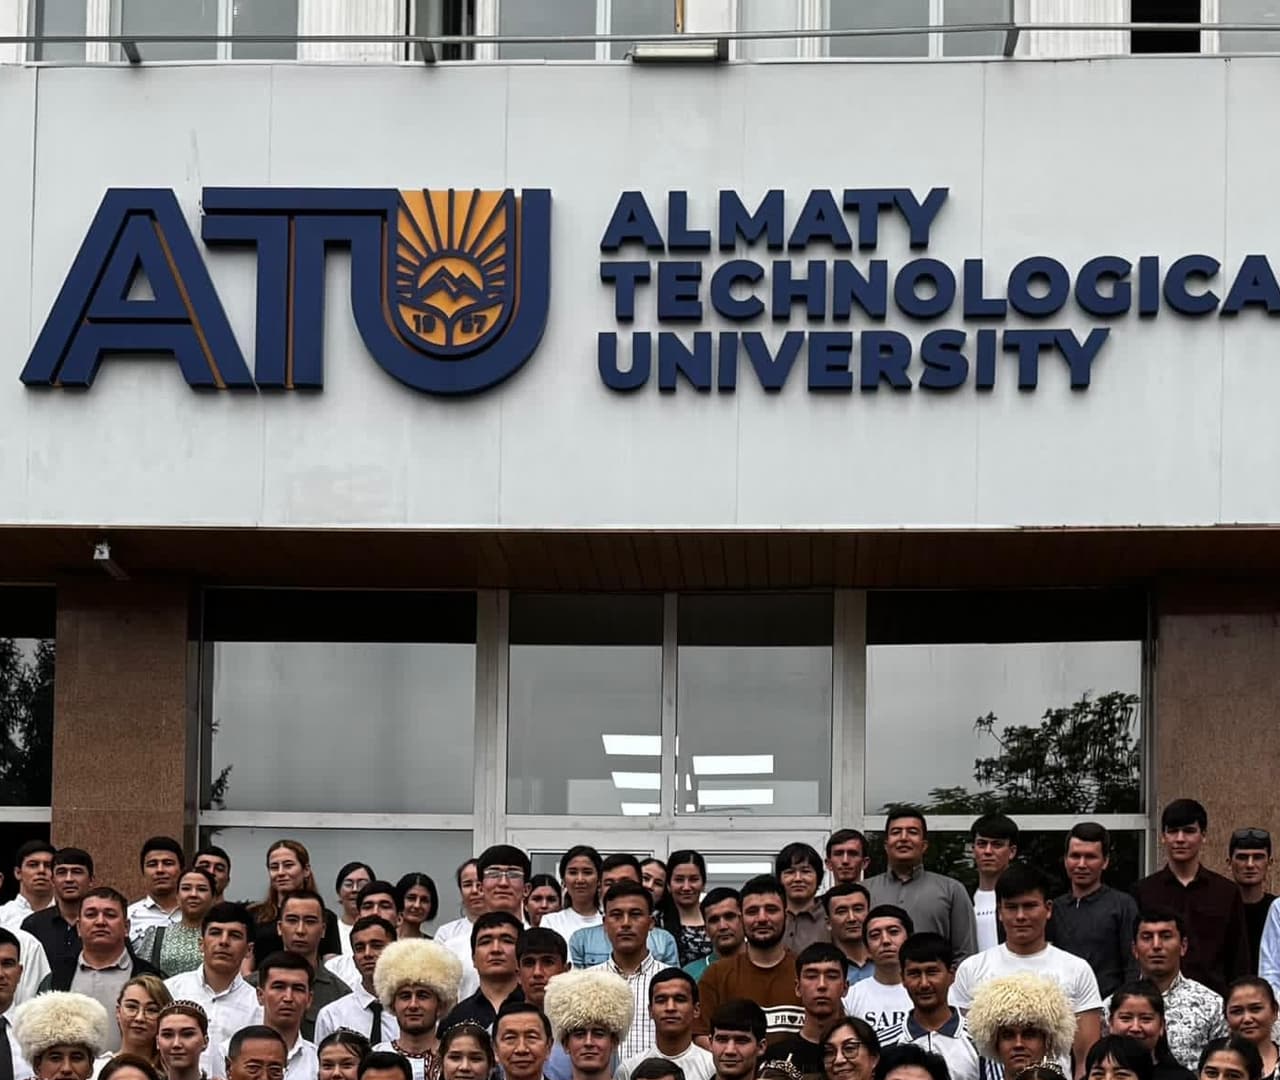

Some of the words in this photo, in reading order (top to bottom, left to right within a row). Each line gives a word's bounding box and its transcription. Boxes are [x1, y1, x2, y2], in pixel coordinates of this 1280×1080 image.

[600, 187, 949, 252] ALMATY
[19, 186, 552, 397] ATU
[598, 327, 1111, 393] UNIVERSITY
